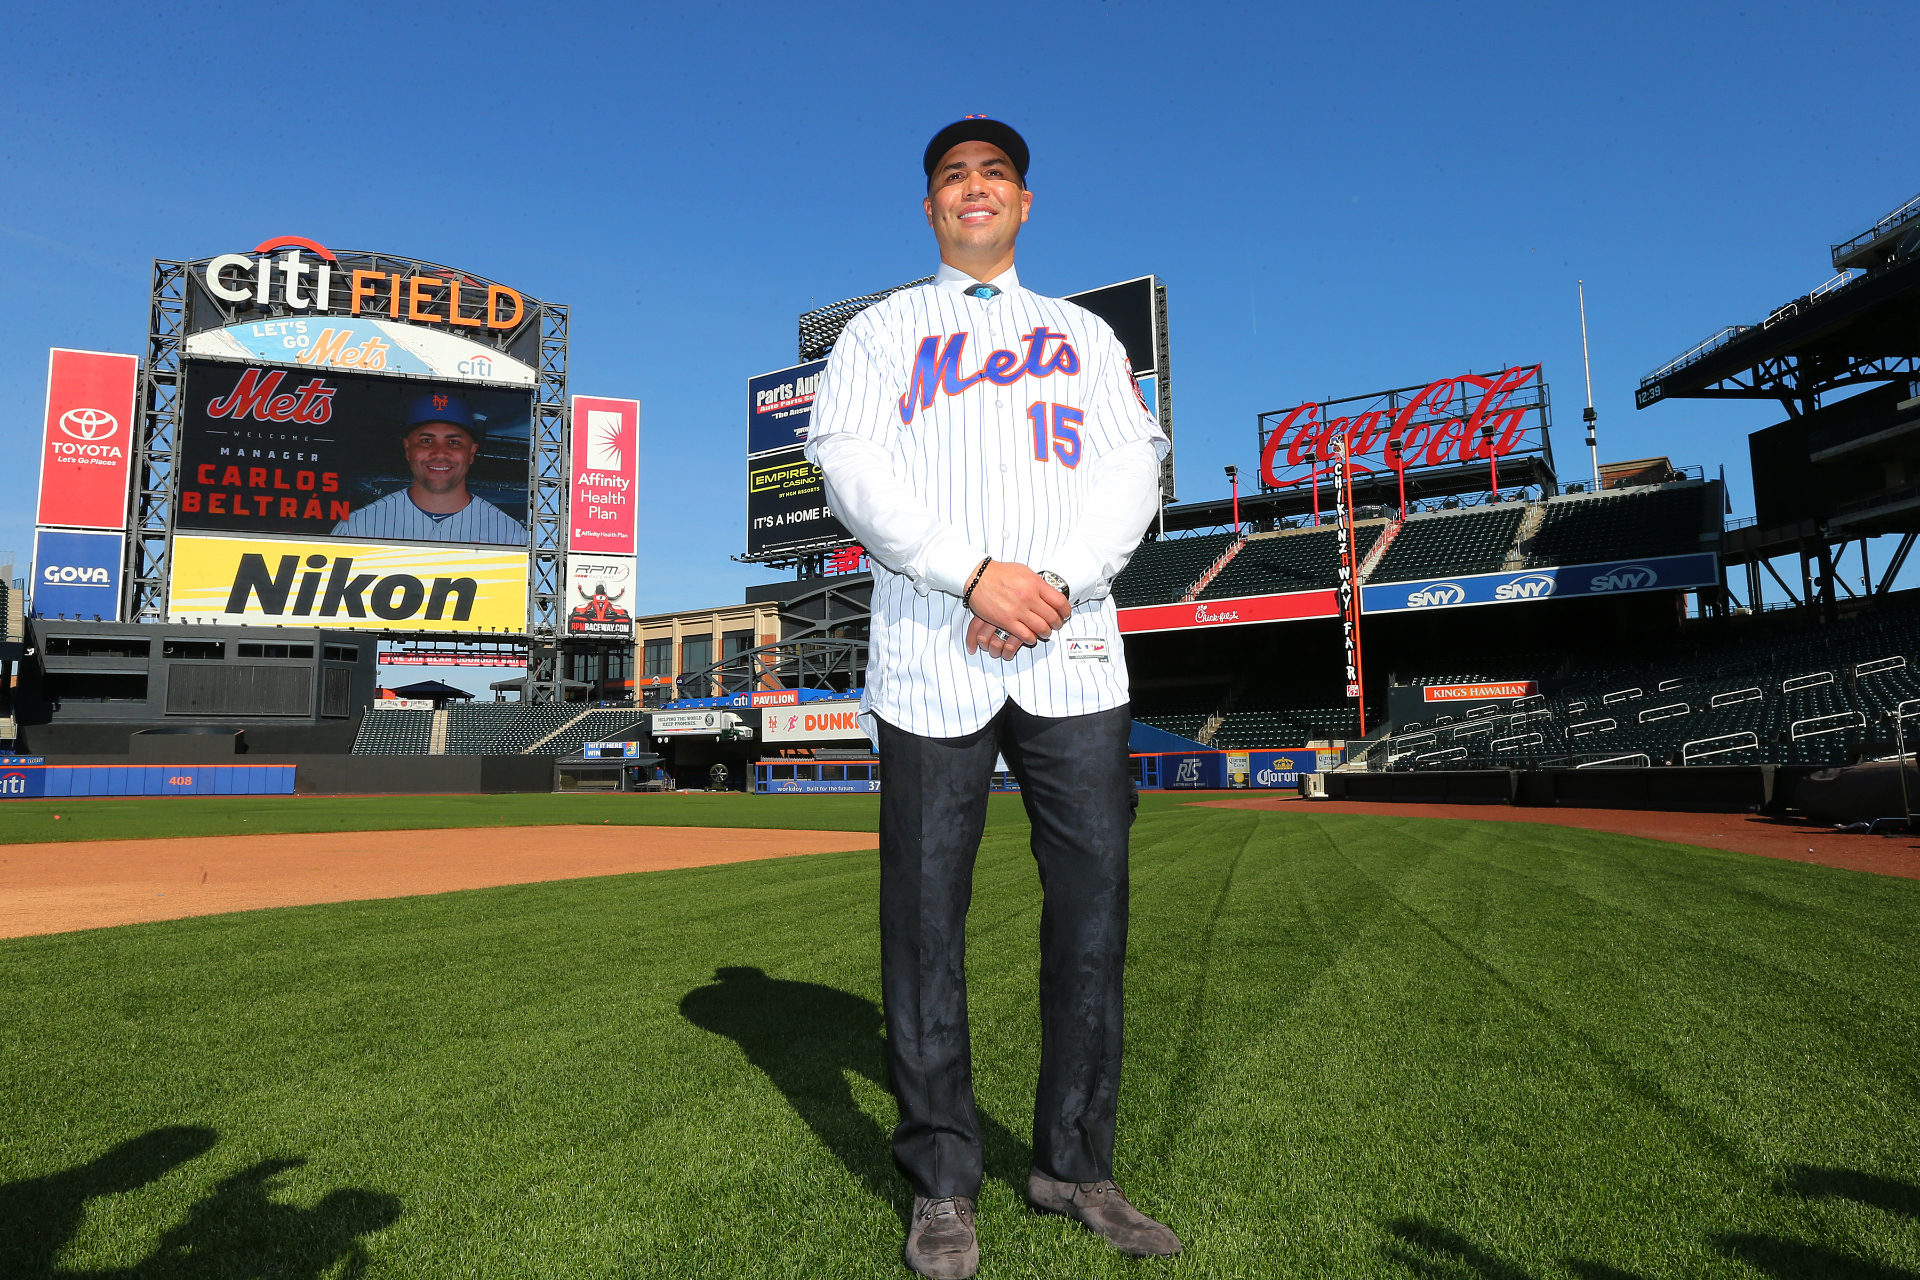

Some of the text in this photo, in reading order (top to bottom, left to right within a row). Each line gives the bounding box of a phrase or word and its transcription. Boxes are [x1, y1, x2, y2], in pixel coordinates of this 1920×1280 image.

[205, 249, 525, 330] citi FIELD
[252, 320, 308, 338] LET'S
[283, 335, 310, 349] GO
[296, 328, 390, 371] Mets
[457, 358, 492, 377] citi
[899, 326, 1081, 425] Mets
[207, 368, 338, 425] Mets
[756, 383, 794, 407] Parts
[1637, 385, 1661, 404] 12:39
[760, 403, 779, 412] Auto
[780, 397, 803, 407] Parts
[1261, 361, 1543, 488] Coca-Cola
[233, 430, 309, 442] WELCOME
[1027, 401, 1084, 469] 15
[51, 441, 122, 458] TOYOTA
[220, 447, 318, 462] MANAGER
[57, 455, 116, 466] Let's Go Places
[197, 463, 339, 493] CARLOS
[577, 472, 631, 491] Affinity
[755, 466, 809, 486] EMPIRE
[782, 476, 816, 488] CASINO
[181, 491, 350, 521] BELTRÁN
[580, 489, 626, 505] Health
[588, 505, 617, 520] Plan
[1333, 462, 1349, 555] CHIKINZ
[753, 516, 774, 530] IT'S
[775, 514, 784, 526] A
[786, 507, 820, 524] HOME
[581, 530, 600, 538] Affinity
[575, 564, 618, 575] RPM
[224, 552, 478, 622] Nikon
[1338, 566, 1351, 611] WAY
[1495, 581, 1547, 600] SNY
[1590, 573, 1646, 592] SNY
[1407, 588, 1456, 608] SNY
[571, 622, 630, 633] RPMRACEWAY.COM
[1343, 621, 1357, 681] FAIR
[733, 694, 795, 706] citi PAVILION
[1433, 685, 1526, 698] KING'S HAWAIIAN
[168, 776, 192, 786] 408
[1256, 768, 1306, 787] Coron
